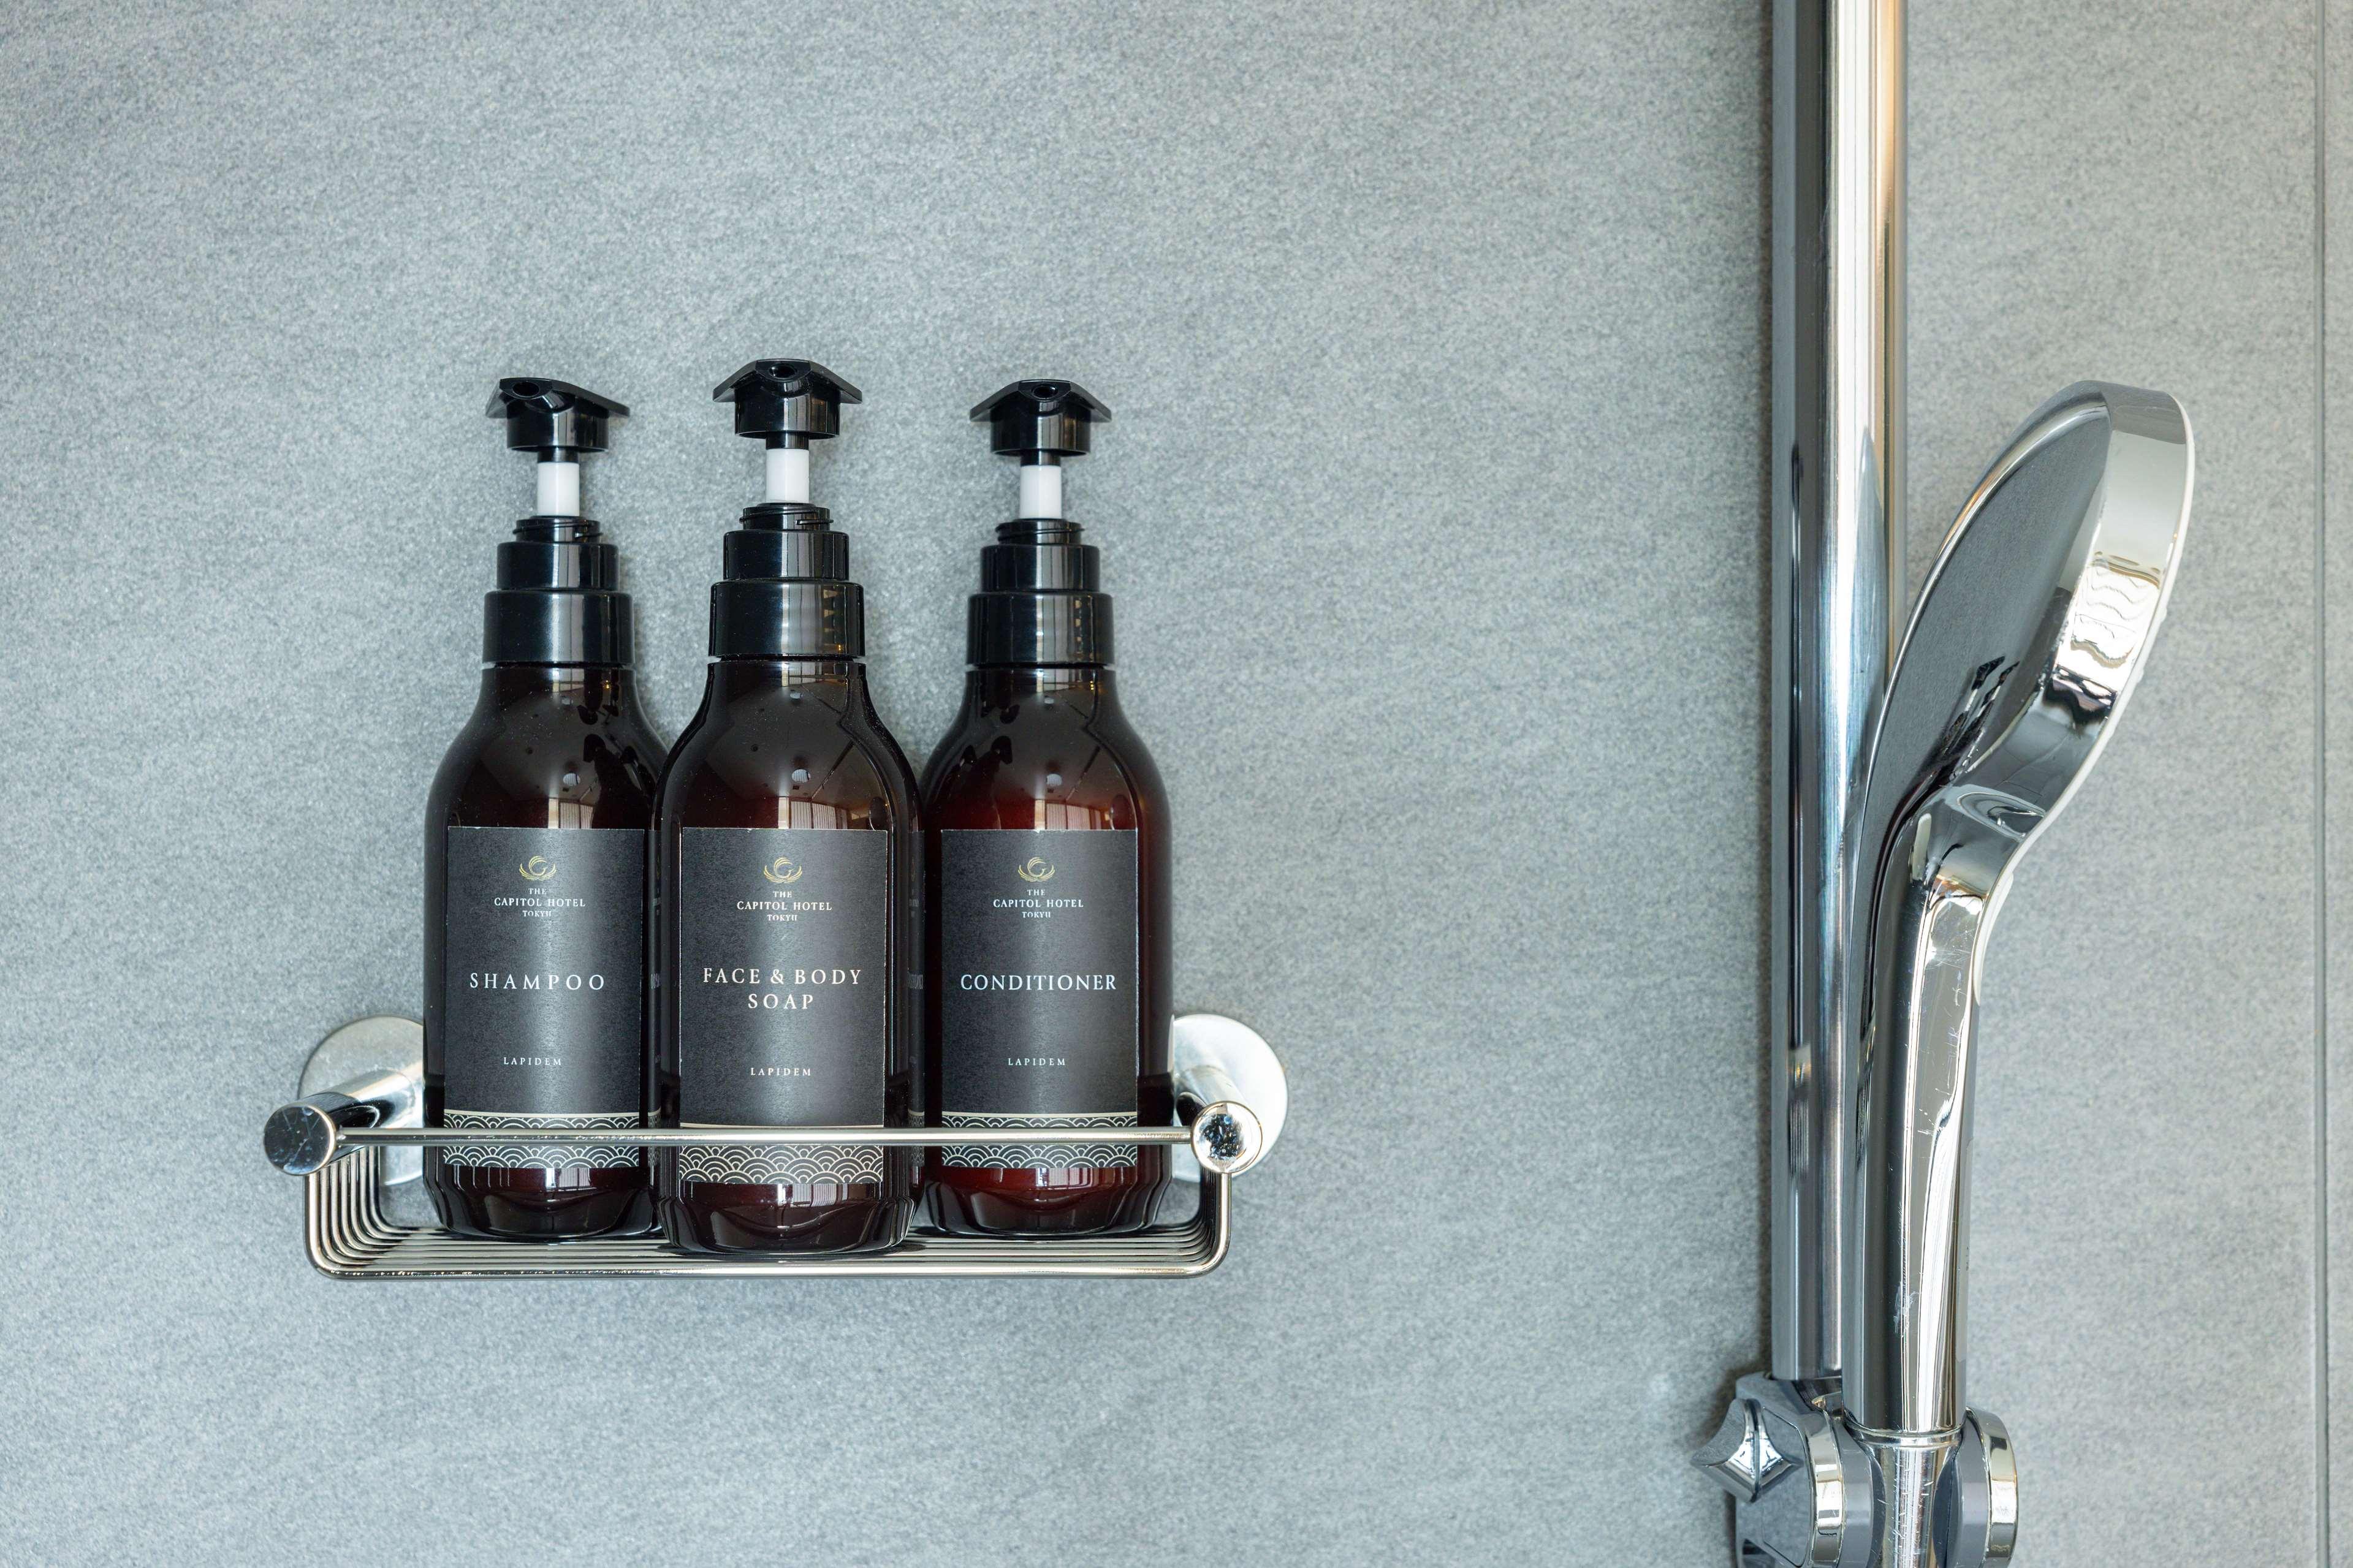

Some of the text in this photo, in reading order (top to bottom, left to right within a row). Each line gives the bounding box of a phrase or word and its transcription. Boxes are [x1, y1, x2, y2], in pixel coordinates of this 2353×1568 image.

[494, 897, 586, 907] CAPITOL HOTEL
[737, 901, 832, 911] CAPITOL HOTEL
[992, 899, 1084, 907] CAPITOL HOTEL
[469, 972, 605, 990] SHAMPOO
[702, 968, 862, 985] FACE & BODY
[960, 974, 1117, 991] CONDITIONER
[747, 993, 814, 1009] SOAP
[503, 1056, 562, 1066] LAPIDEM
[1008, 1058, 1066, 1066] LAPIDEM
[750, 1067, 811, 1077] LAPIDEM
